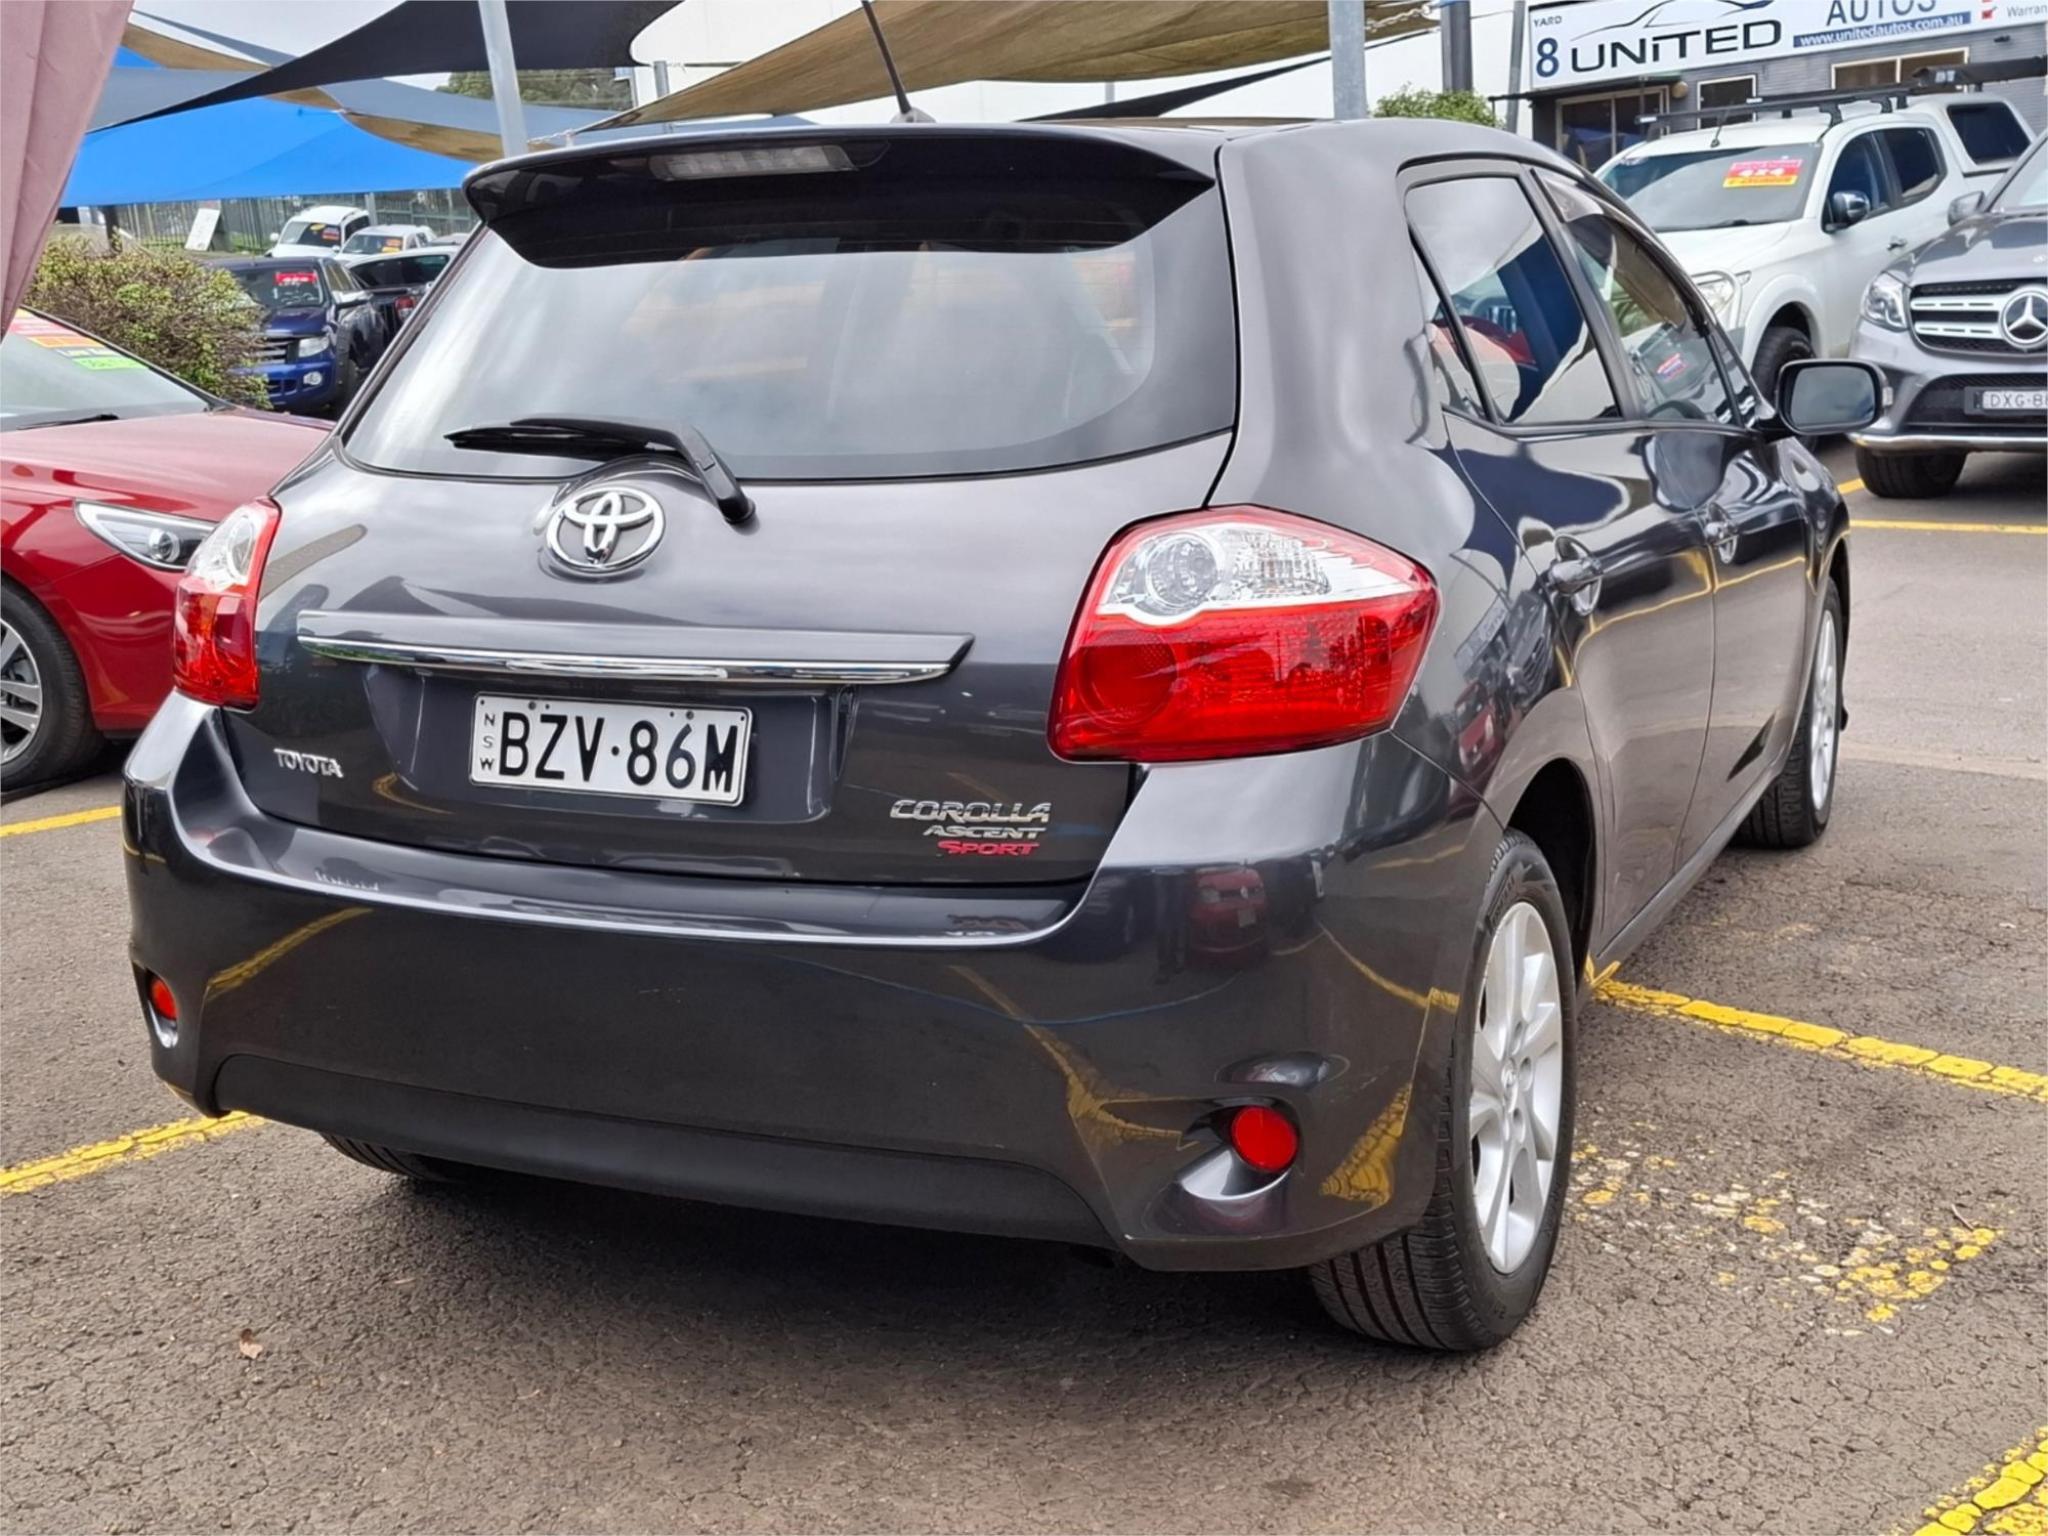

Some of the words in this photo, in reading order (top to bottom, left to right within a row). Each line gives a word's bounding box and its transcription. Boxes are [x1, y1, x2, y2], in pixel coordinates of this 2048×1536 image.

[1533, 15, 1562, 28] YARD
[1800, 14, 1964, 47] www.unitedautos.com.au
[1536, 37, 1560, 78] 8
[1990, 393, 2047, 408] DXG·8
[273, 748, 343, 778] TOYOTA
[889, 799, 1052, 823] COROLLA
[923, 824, 1047, 839] ASCENT
[937, 839, 1040, 856] SPORT
